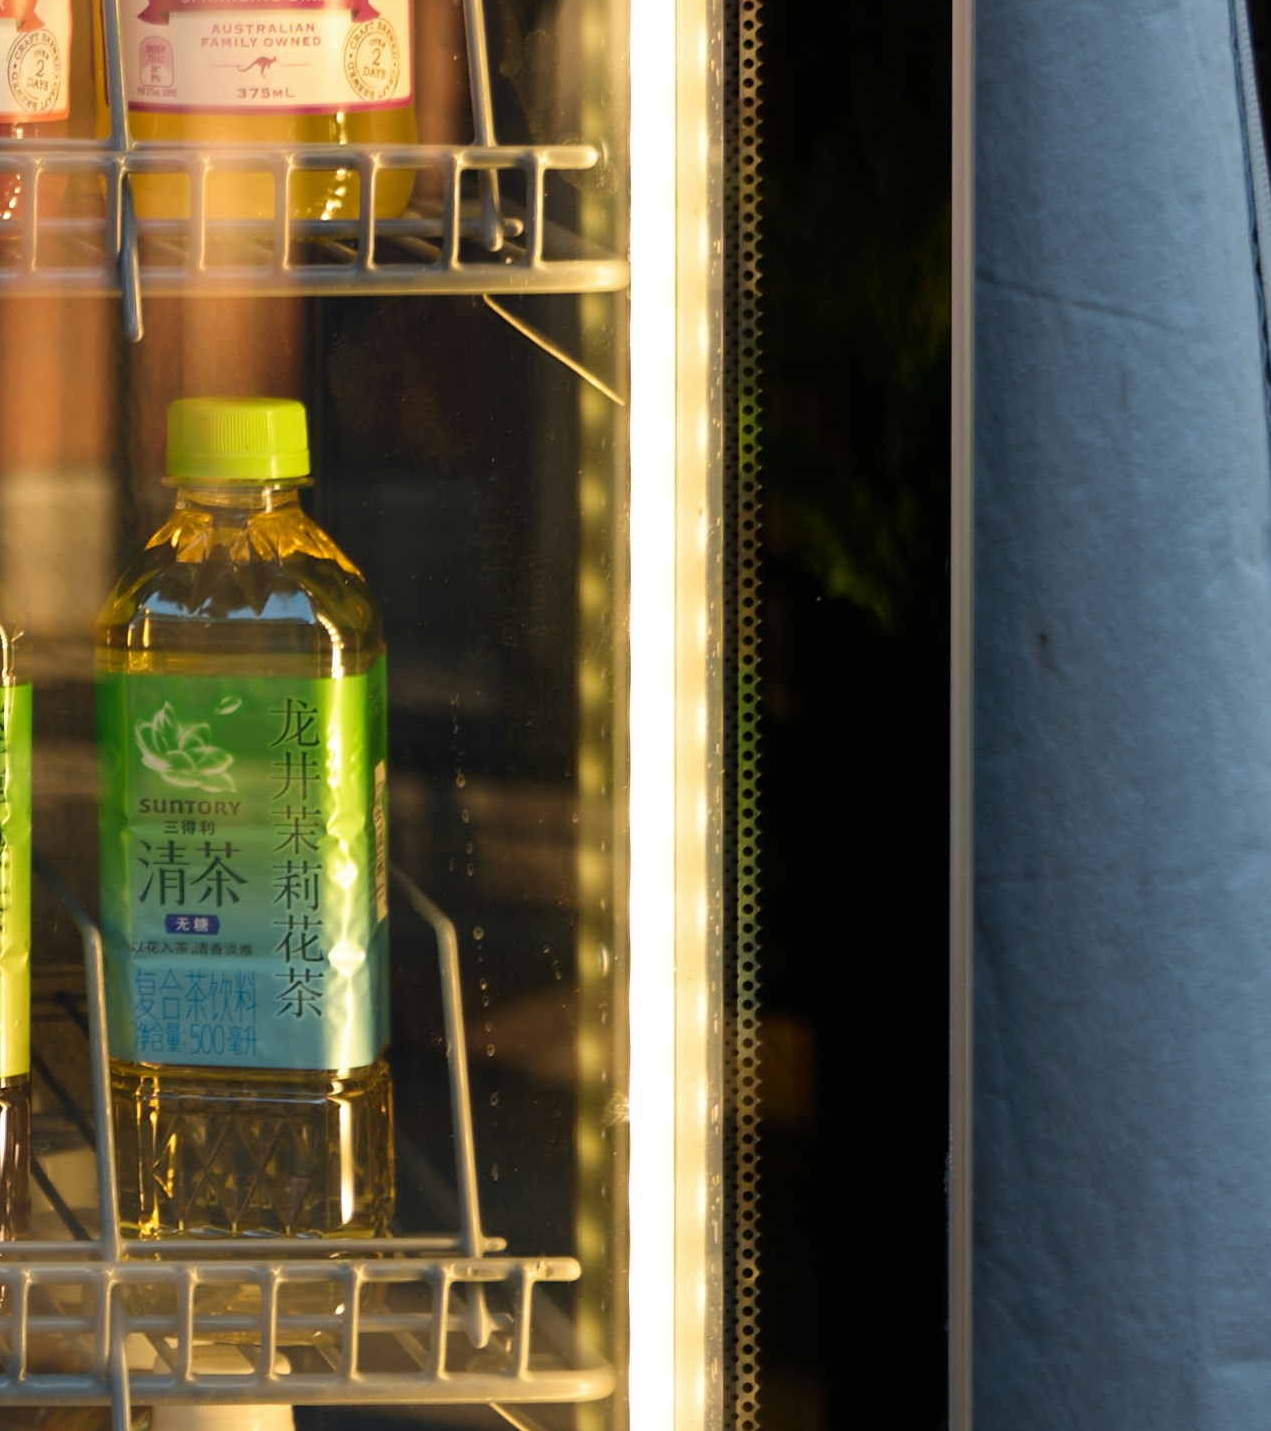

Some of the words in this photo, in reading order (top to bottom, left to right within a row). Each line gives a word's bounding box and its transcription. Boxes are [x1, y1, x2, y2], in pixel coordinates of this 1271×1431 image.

[139, 797, 242, 817] SUNTORY
[136, 840, 249, 909] 清茶
[268, 696, 324, 1020] 龙井茉莉花茶
